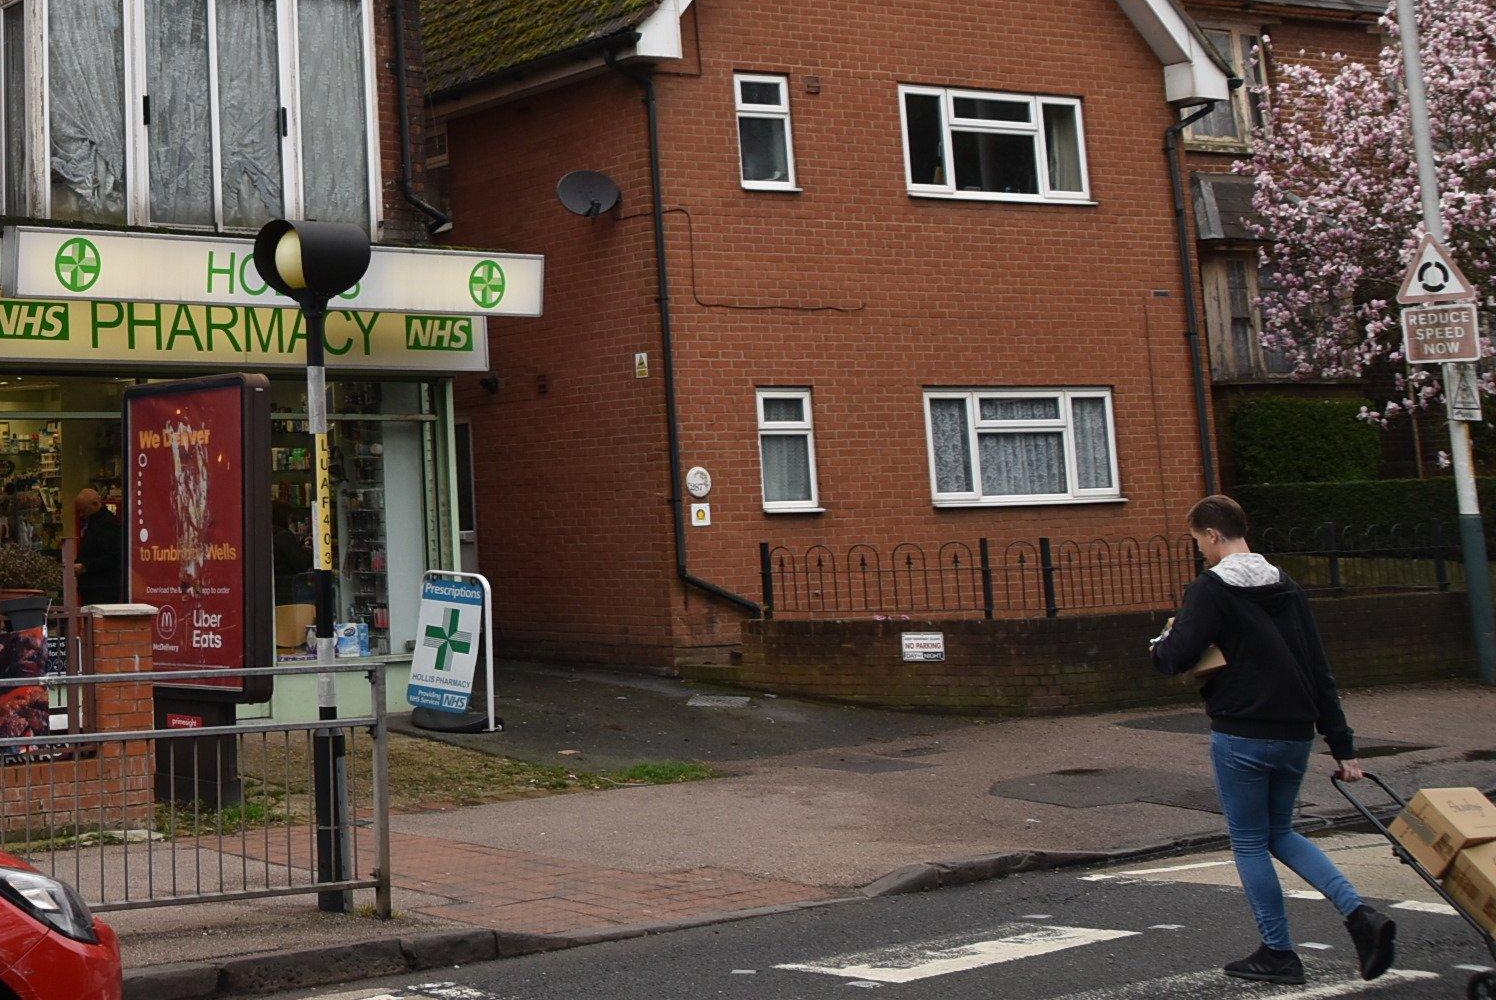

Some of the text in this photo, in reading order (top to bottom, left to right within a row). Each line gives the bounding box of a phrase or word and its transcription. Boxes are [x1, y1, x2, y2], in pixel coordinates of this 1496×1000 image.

[1408, 311, 1470, 326] REDUCE
[408, 318, 469, 349] NHS
[1416, 326, 1464, 340] SPEED
[1424, 341, 1460, 355] NOW
[139, 430, 160, 449] We
[140, 546, 151, 561] to
[425, 582, 481, 600] Prescriptions
[194, 610, 222, 628] Uber
[192, 629, 222, 648] Eats
[916, 642, 942, 650] PARKING
[436, 676, 471, 688] PHARMACY
[444, 695, 466, 709] NHS
